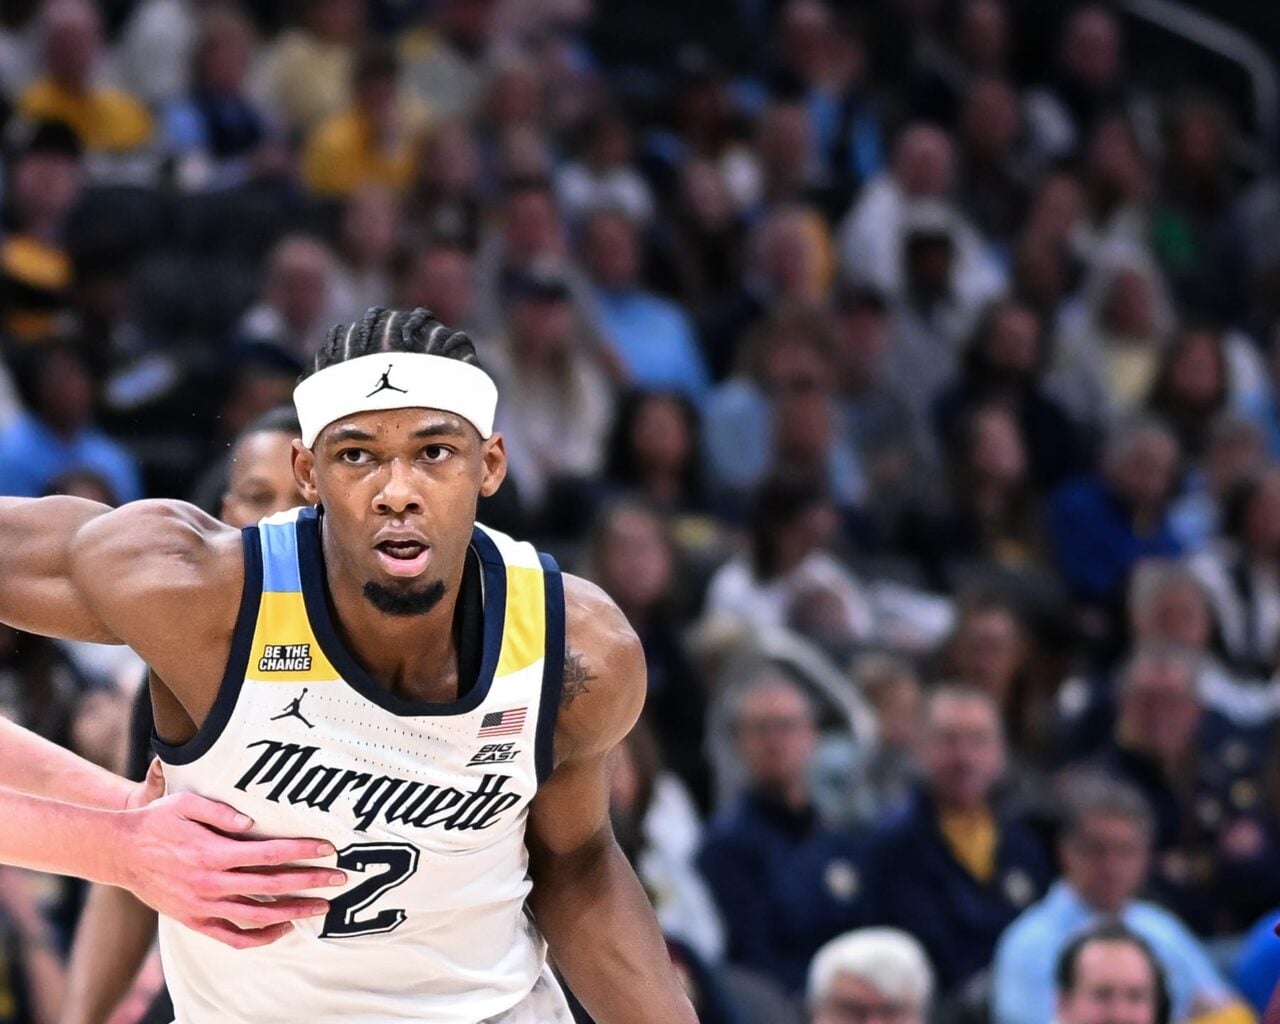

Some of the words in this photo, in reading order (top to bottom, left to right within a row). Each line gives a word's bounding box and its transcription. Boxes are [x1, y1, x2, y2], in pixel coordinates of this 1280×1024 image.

[264, 646, 281, 658] BE
[285, 645, 309, 658] THE
[259, 657, 311, 671] CHANGE
[478, 742, 516, 753] BIG
[470, 750, 522, 762] EAST
[234, 739, 522, 832] Marquette
[318, 841, 421, 939] 2
